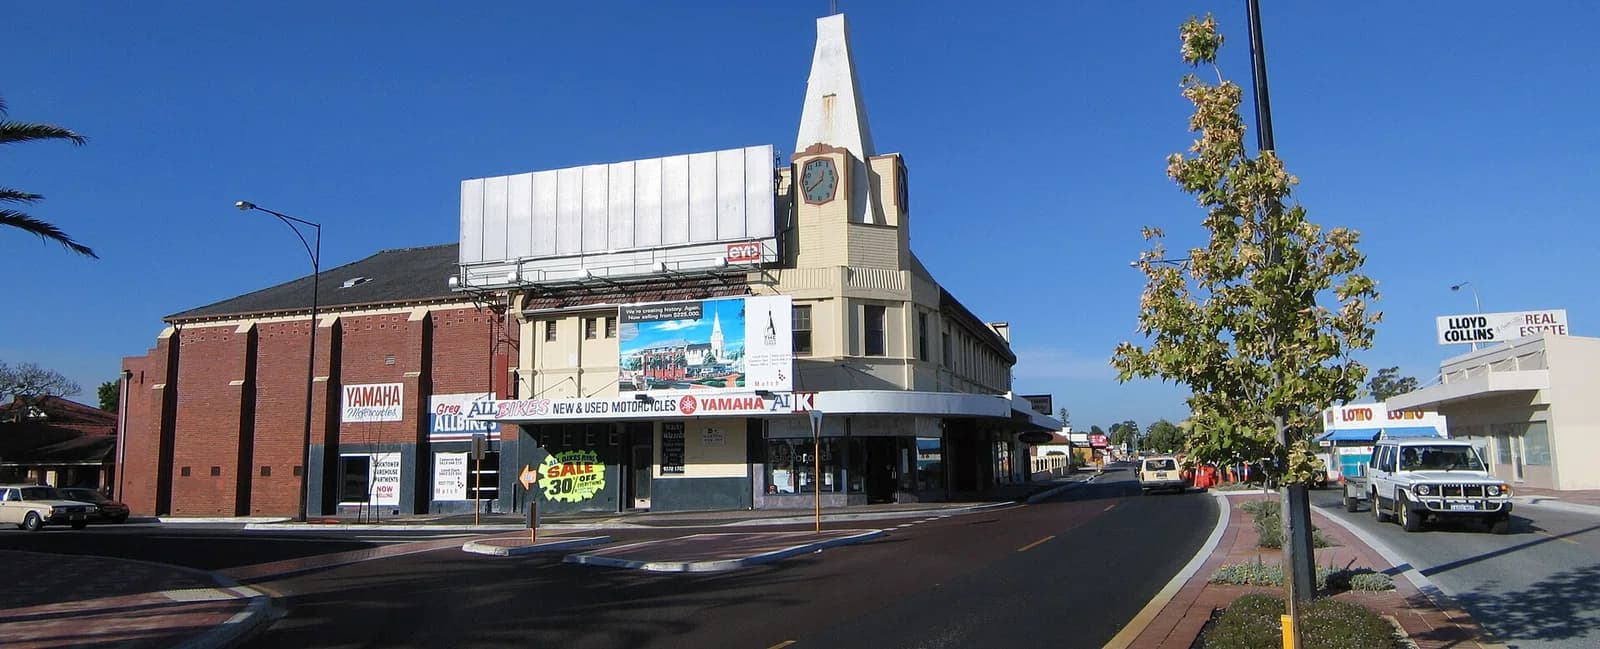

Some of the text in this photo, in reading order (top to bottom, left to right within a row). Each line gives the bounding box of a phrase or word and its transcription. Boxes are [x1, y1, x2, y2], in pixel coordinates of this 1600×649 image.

[1449, 316, 1487, 330] LLOYD
[1525, 313, 1557, 325] REAL
[1444, 328, 1494, 342] COLLINS
[346, 385, 400, 407] YAMAHA
[346, 407, 398, 420] Motorcycles
[436, 403, 461, 416] Greg
[467, 401, 497, 418] ALL
[495, 399, 550, 418] BIKES
[552, 402, 574, 414] NEW
[575, 402, 583, 414] &
[584, 401, 608, 413] USED
[611, 399, 677, 413] MOTORCYCLES
[701, 397, 765, 411] YAMAHA
[1342, 407, 1373, 422] LOTTO
[547, 461, 594, 479] SALE
[579, 474, 597, 482] OFF
